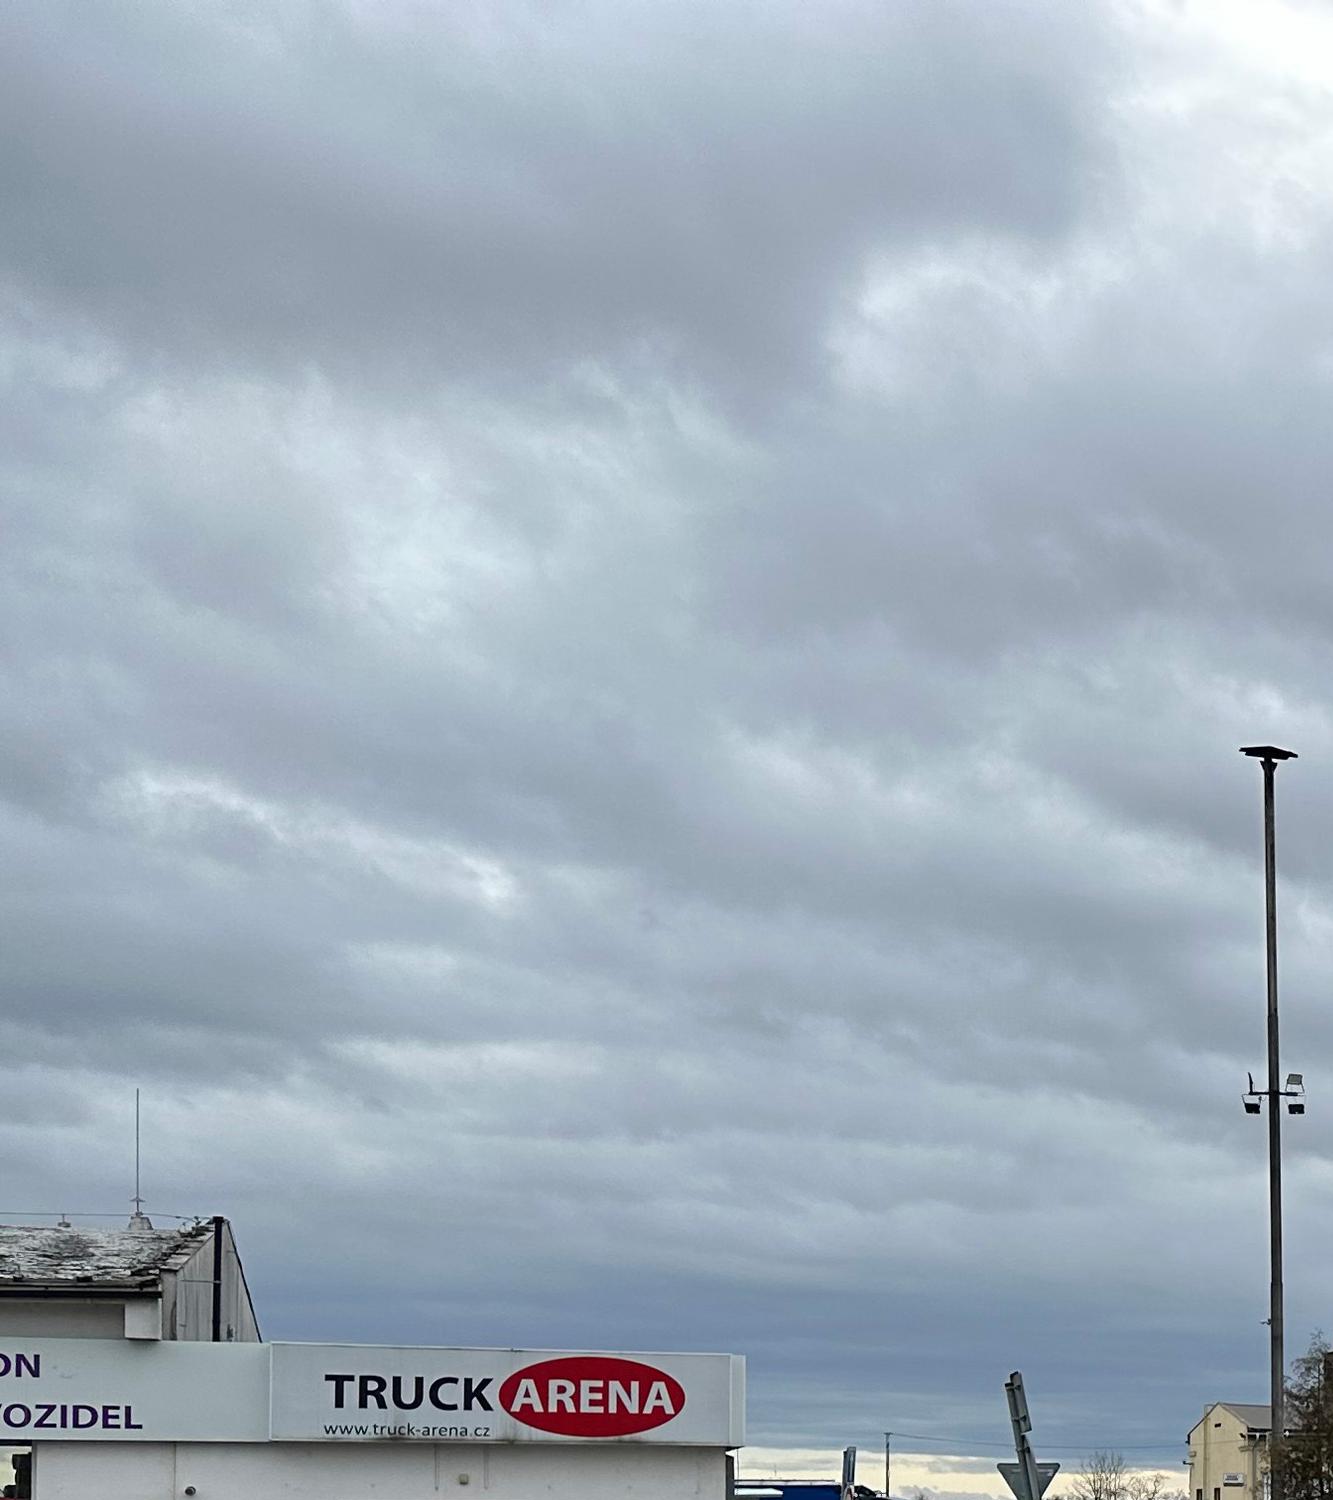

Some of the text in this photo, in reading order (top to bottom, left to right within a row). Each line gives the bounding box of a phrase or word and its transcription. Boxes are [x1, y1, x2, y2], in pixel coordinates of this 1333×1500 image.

[324, 1374, 675, 1415] TRUCK ARENA
[0, 1403, 143, 1429] OZIDEL
[324, 1422, 491, 1438] www.truck-arena.cz
